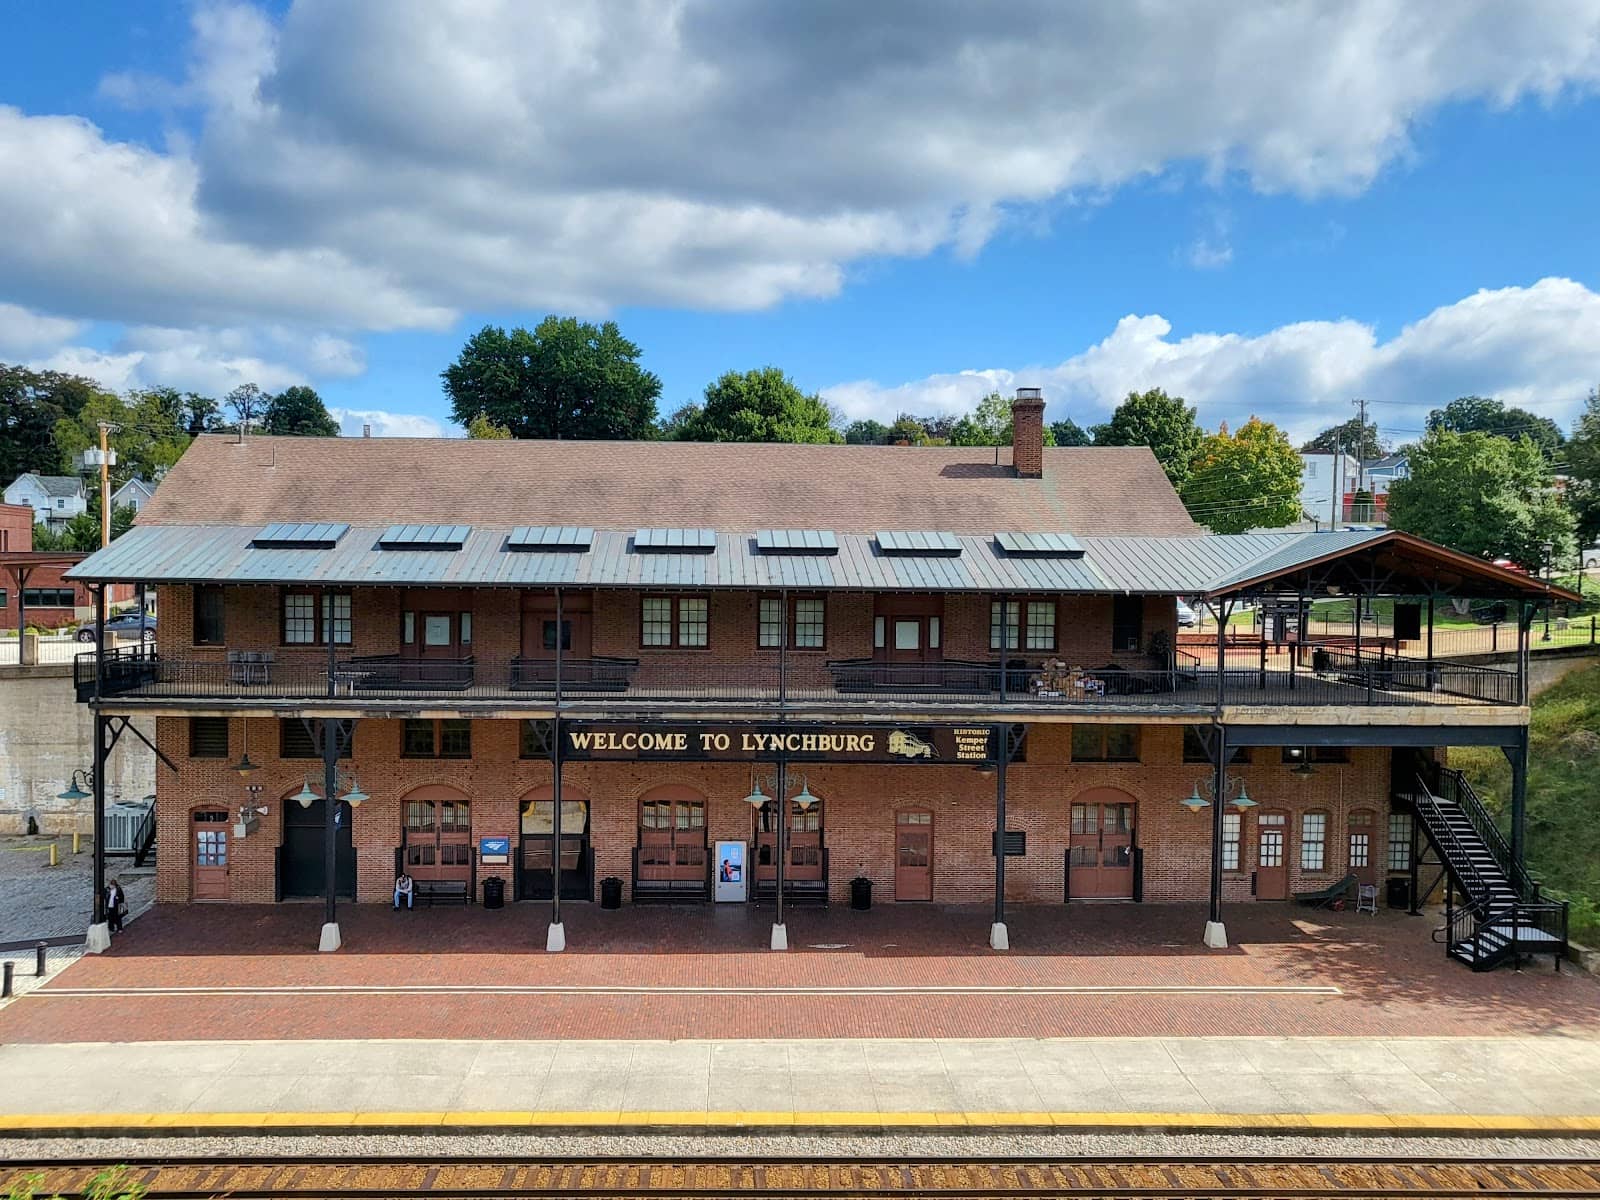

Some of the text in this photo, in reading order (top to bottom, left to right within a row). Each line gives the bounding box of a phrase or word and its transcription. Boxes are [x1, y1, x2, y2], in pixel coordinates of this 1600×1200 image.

[569, 733, 876, 752] WELCOME TO LYNCHBURG
[955, 736, 988, 745] Kemper
